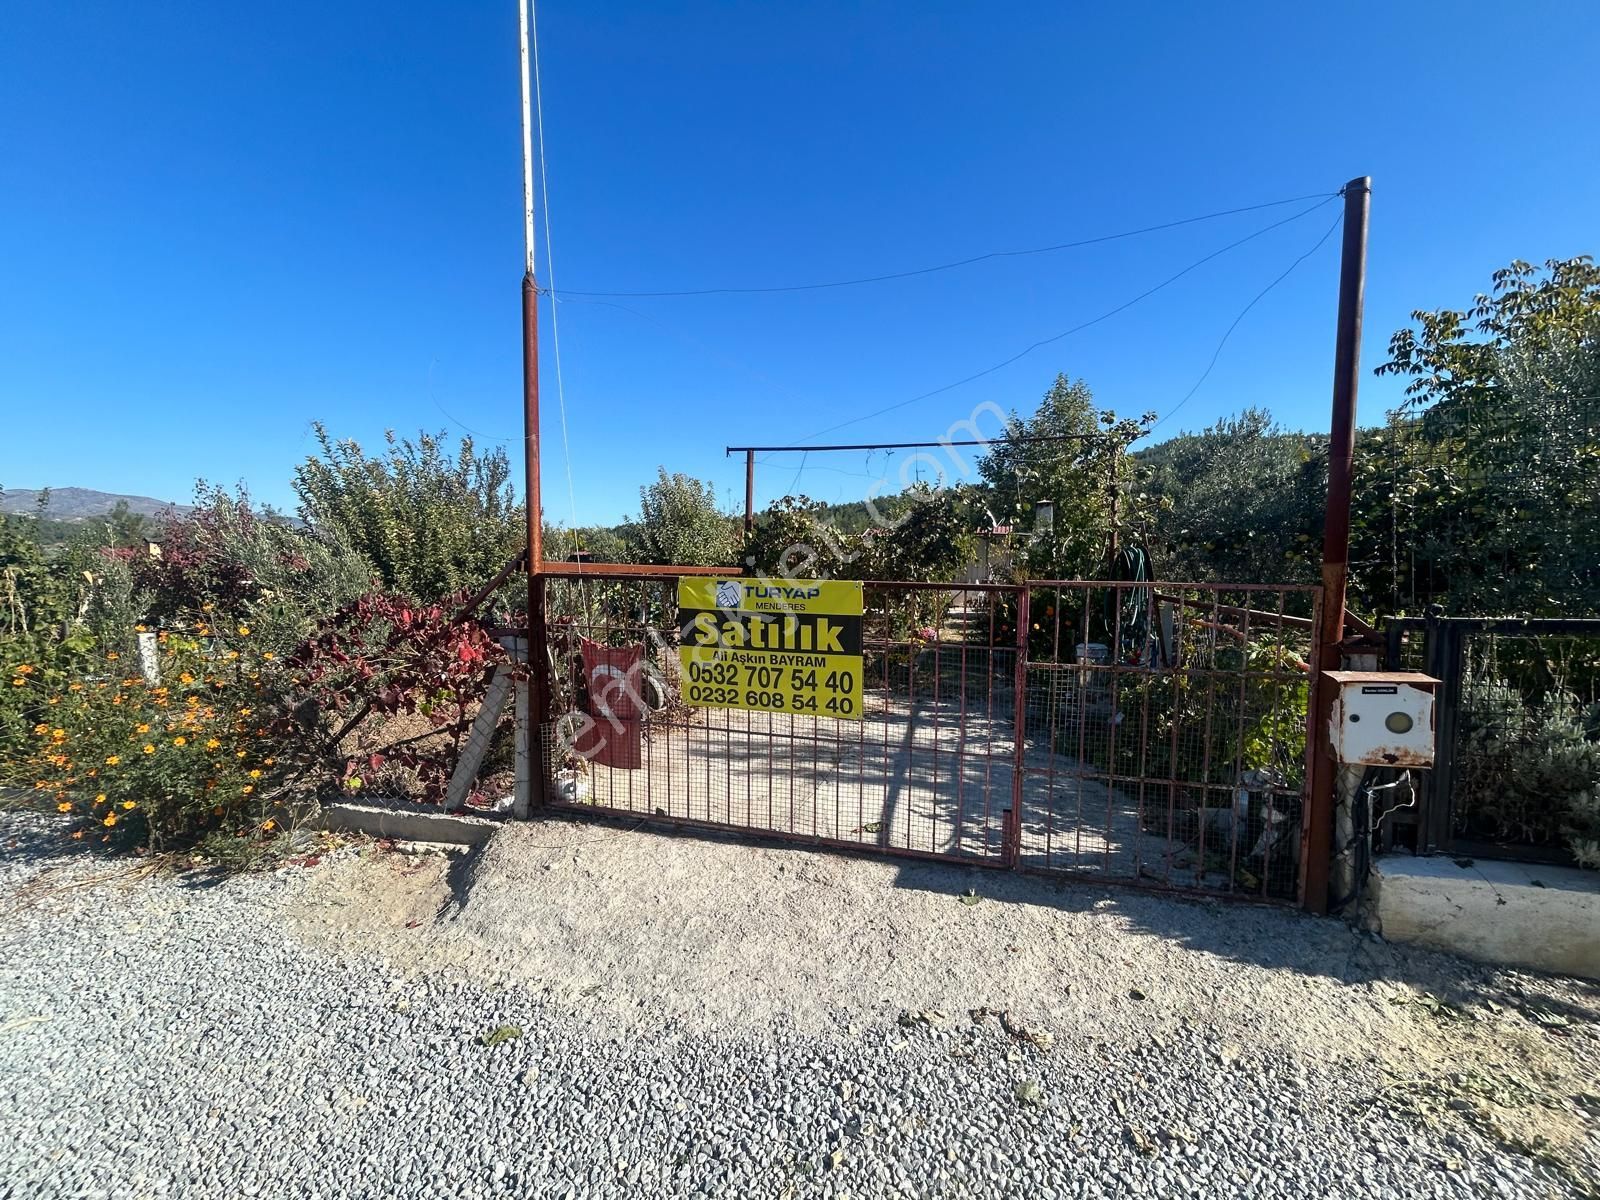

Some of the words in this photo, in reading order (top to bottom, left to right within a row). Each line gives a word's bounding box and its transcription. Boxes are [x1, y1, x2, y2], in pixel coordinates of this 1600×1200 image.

[744, 586, 820, 600] TURYAP
[755, 602, 806, 611] MENDERES
[694, 612, 844, 652] Satılık
[712, 651, 727, 662] Ali
[731, 652, 766, 665] Aşkın
[770, 655, 826, 668] BAYRAM
[689, 661, 739, 686] 0532
[745, 666, 784, 689] 707
[791, 669, 818, 692] 54
[825, 671, 853, 694] 40
[689, 686, 739, 705] 0232
[745, 690, 785, 709] 608
[791, 695, 818, 711] 54
[825, 697, 853, 714] 40
